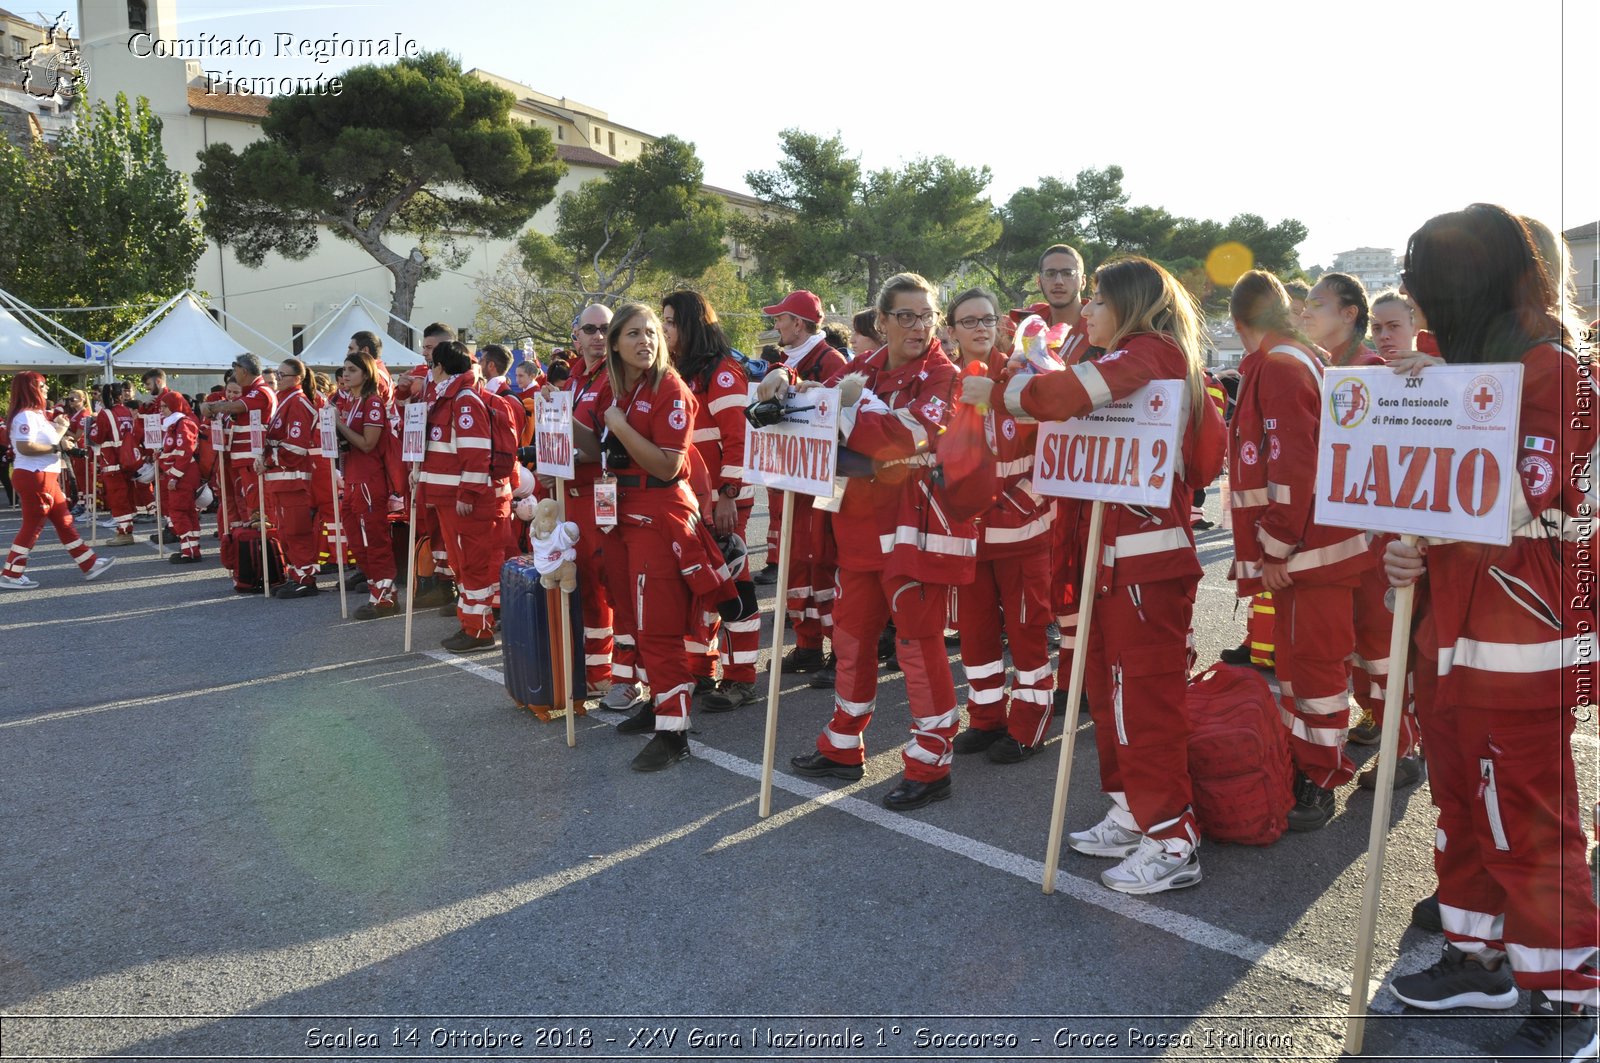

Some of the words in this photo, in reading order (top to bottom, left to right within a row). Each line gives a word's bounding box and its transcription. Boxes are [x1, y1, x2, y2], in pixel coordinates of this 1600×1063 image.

[1405, 378, 1424, 388] XXV
[1378, 397, 1399, 407] Gara
[1402, 397, 1449, 407] Nazionale
[1106, 415, 1135, 423] Soccorso
[1372, 415, 1380, 424] di
[1383, 415, 1409, 425] Primo
[1412, 416, 1453, 426] Soccorso
[749, 431, 832, 482] PIEMONTE
[1040, 433, 1140, 487] SICILIA
[1148, 439, 1168, 490] 2
[1328, 443, 1501, 517] LAZIO
